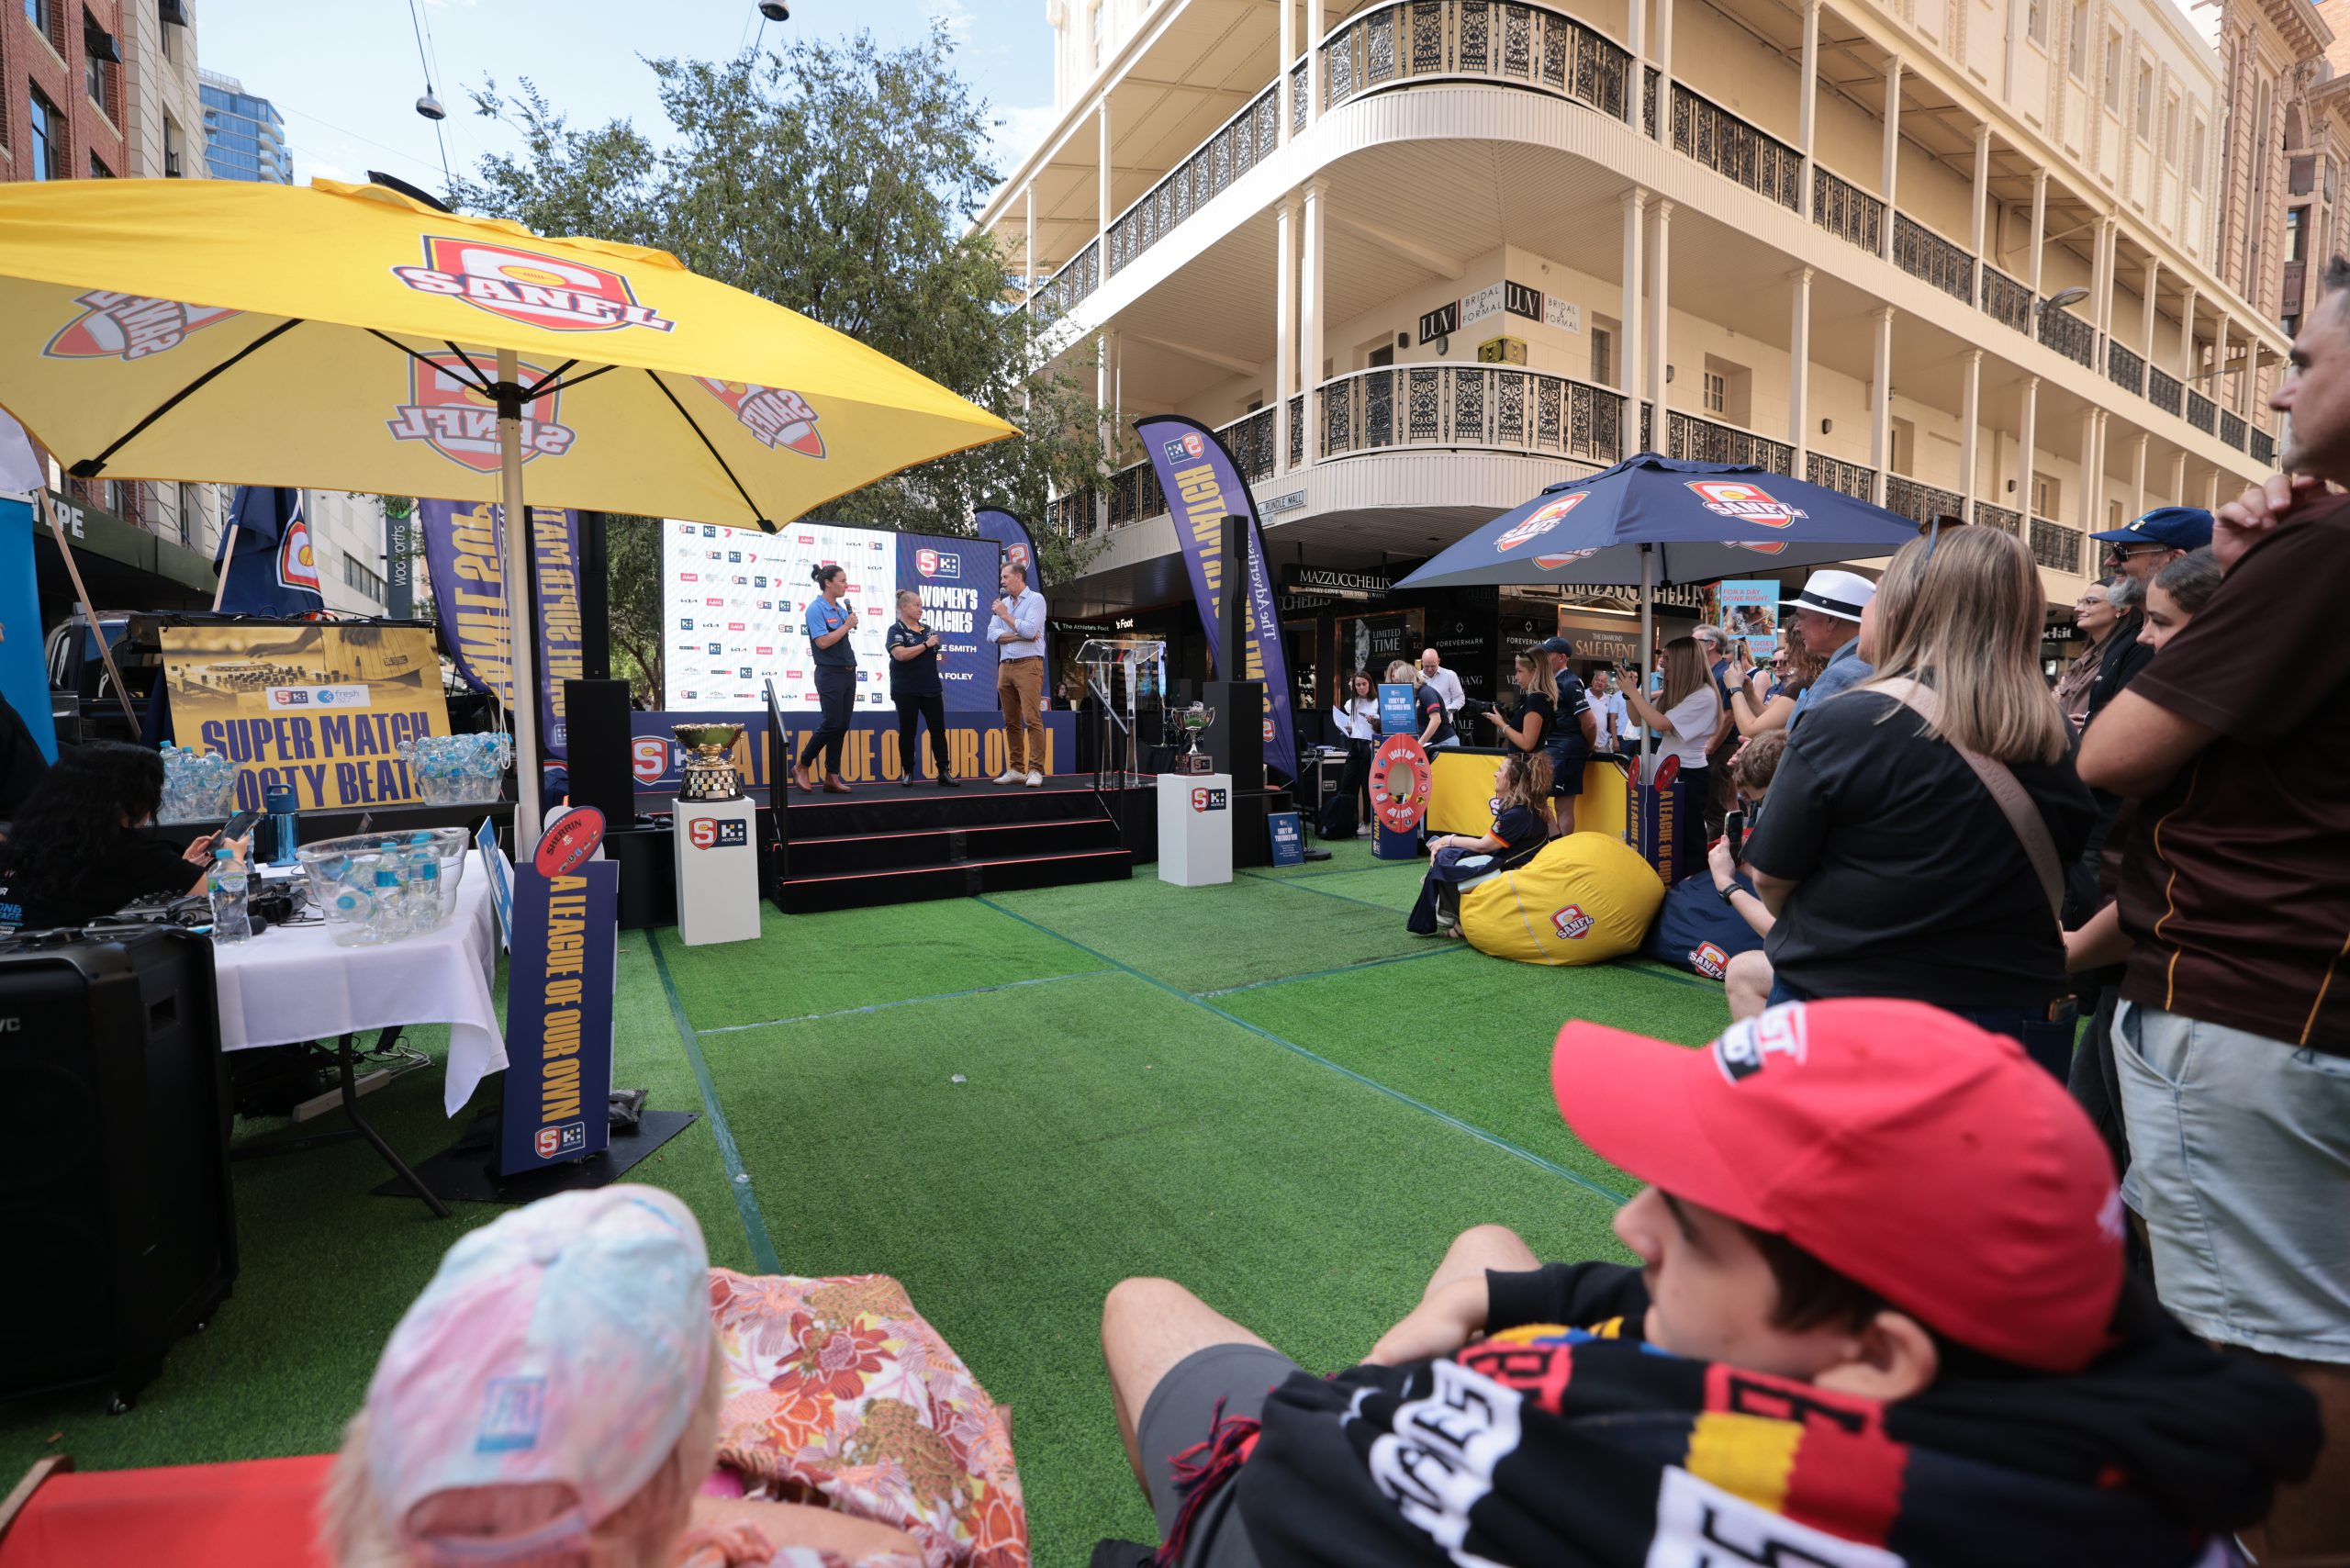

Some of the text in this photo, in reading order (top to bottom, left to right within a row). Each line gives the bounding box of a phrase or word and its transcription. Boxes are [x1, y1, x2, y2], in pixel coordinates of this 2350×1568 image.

[395, 266, 676, 331] SANFL
[1465, 286, 1499, 308] BRIDAL
[1507, 285, 1539, 316] LUV
[1548, 297, 1576, 315] BRIDAL
[1421, 306, 1454, 342] LUV
[1462, 301, 1502, 324] FORMAL
[1546, 312, 1578, 330] FORMAL
[1265, 498, 1285, 512] RUNDLE
[1287, 493, 1302, 505] MALL
[1702, 501, 1808, 519] SANFL
[390, 525, 407, 587] Woolorths
[919, 585, 979, 610] WOMEN'S
[919, 610, 973, 633] COACHES
[1121, 618, 1134, 629] Foot
[1372, 628, 1401, 639] LIMITED
[1436, 637, 1484, 648] FOREVERMARK
[1506, 636, 1547, 646] FOREVERMAR
[1593, 633, 1603, 641] THE
[948, 644, 977, 653] SMITH
[1372, 638, 1401, 653] TIME
[1575, 640, 1637, 659] SALE EVENT
[945, 672, 974, 680] FOLEY
[201, 716, 317, 764] SUPER
[319, 711, 431, 758] MATCH
[731, 730, 755, 786] A
[984, 727, 1054, 777] ON
[236, 763, 327, 813] OOTY
[335, 757, 425, 805] BEAT
[1660, 790, 1674, 800] A
[1630, 801, 1639, 842] LEAGUE
[1659, 801, 1673, 845] LEAGUE
[546, 819, 583, 856] SHERRIN
[1658, 845, 1673, 857] OF
[1557, 914, 1595, 939] SANFL
[1688, 950, 1727, 980] SANFL
[542, 875, 588, 1123] A LEAGUE OF OUR OWN
[563, 1138, 582, 1148] HOSTPLUS
